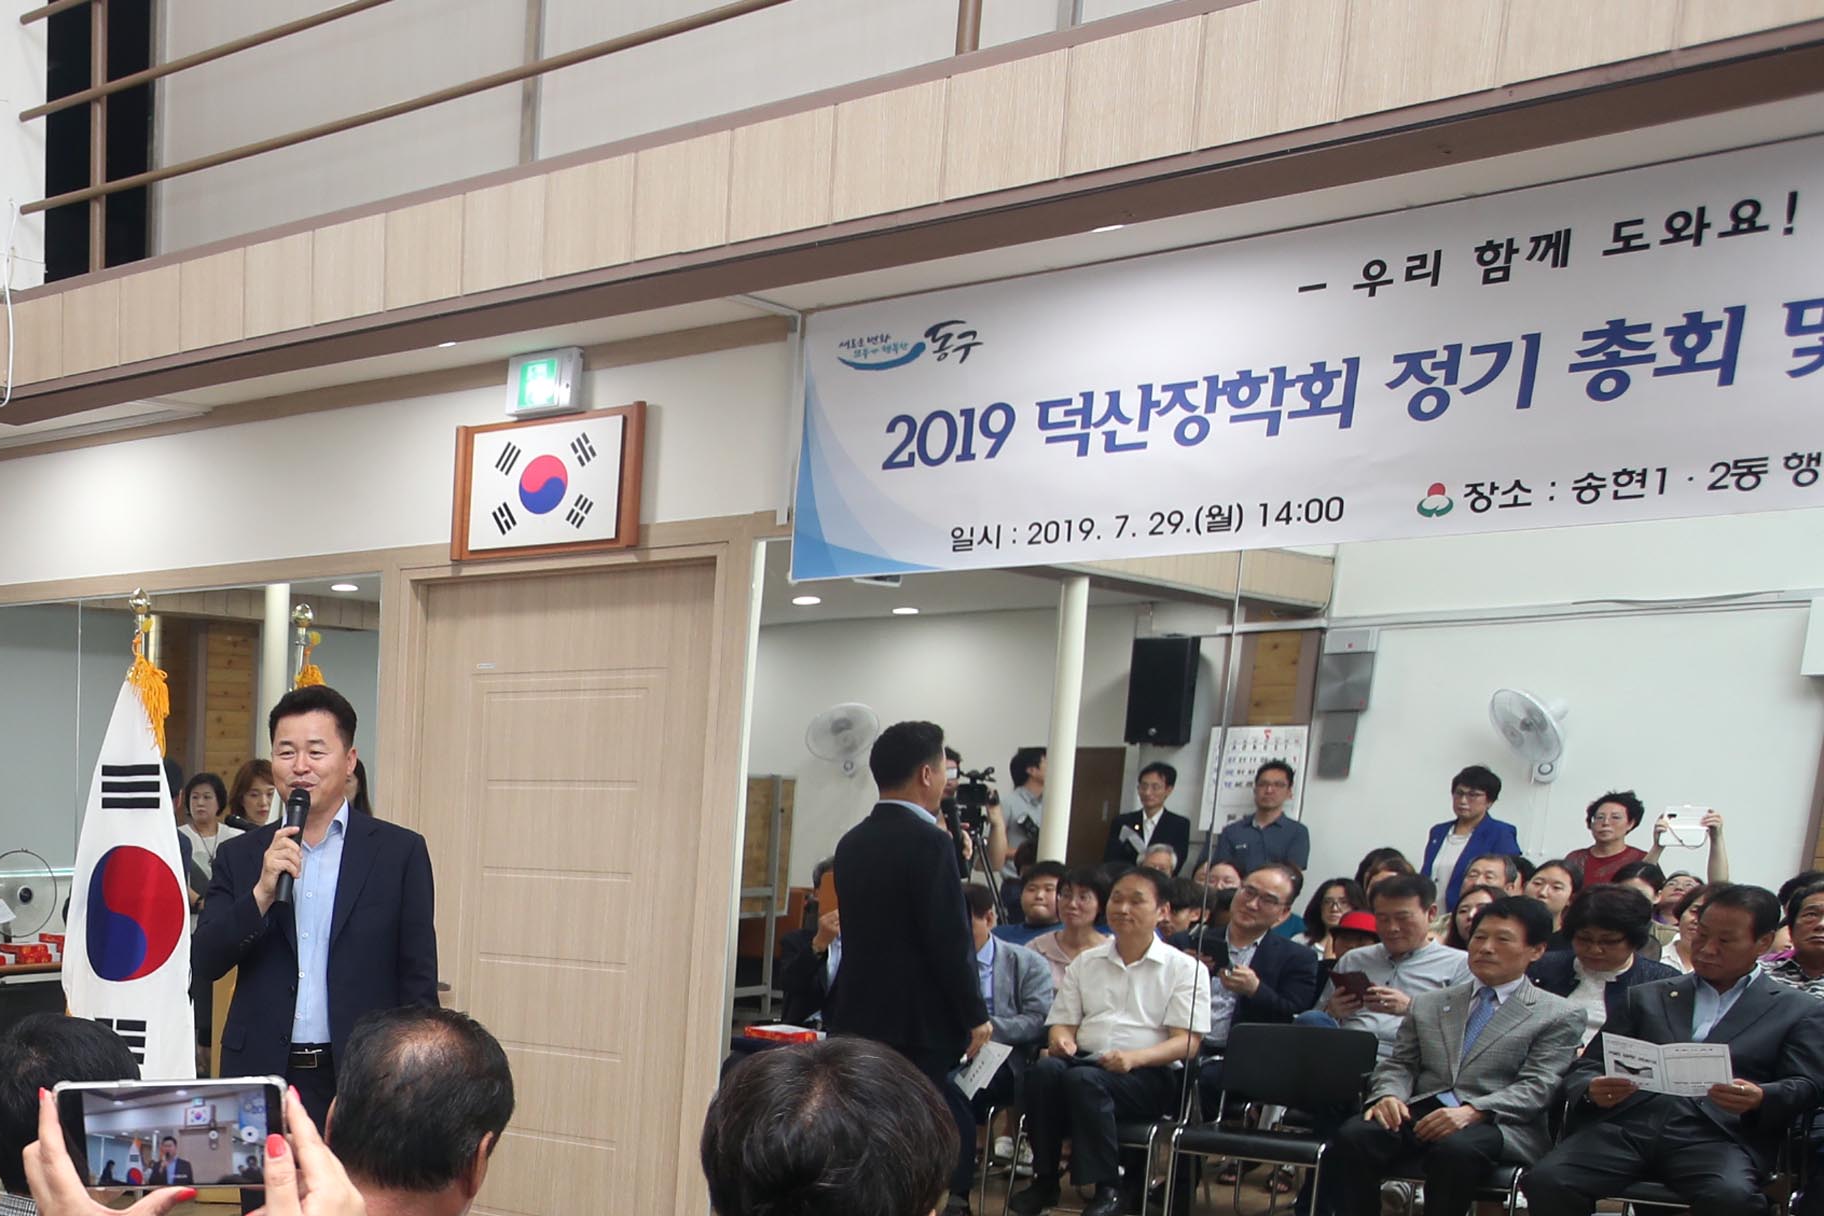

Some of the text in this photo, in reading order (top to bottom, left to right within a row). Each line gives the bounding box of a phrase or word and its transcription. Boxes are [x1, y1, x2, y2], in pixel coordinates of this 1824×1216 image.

[1353, 248, 1443, 298] 우리
[1474, 227, 1572, 286] 함께
[1602, 190, 1799, 257] 도와요!
[924, 319, 984, 364] 동구
[881, 401, 1016, 471] 2019
[1035, 356, 1361, 458] 덕산장학회
[1385, 331, 1542, 422] 정기
[1567, 304, 1747, 402] 총회
[950, 524, 1002, 553] 일시
[1027, 517, 1101, 545] 2019.
[1115, 514, 1137, 539] 7.
[1148, 502, 1244, 536] 29.(월)
[1259, 496, 1345, 527] 14:00
[1463, 479, 1532, 514] 장소
